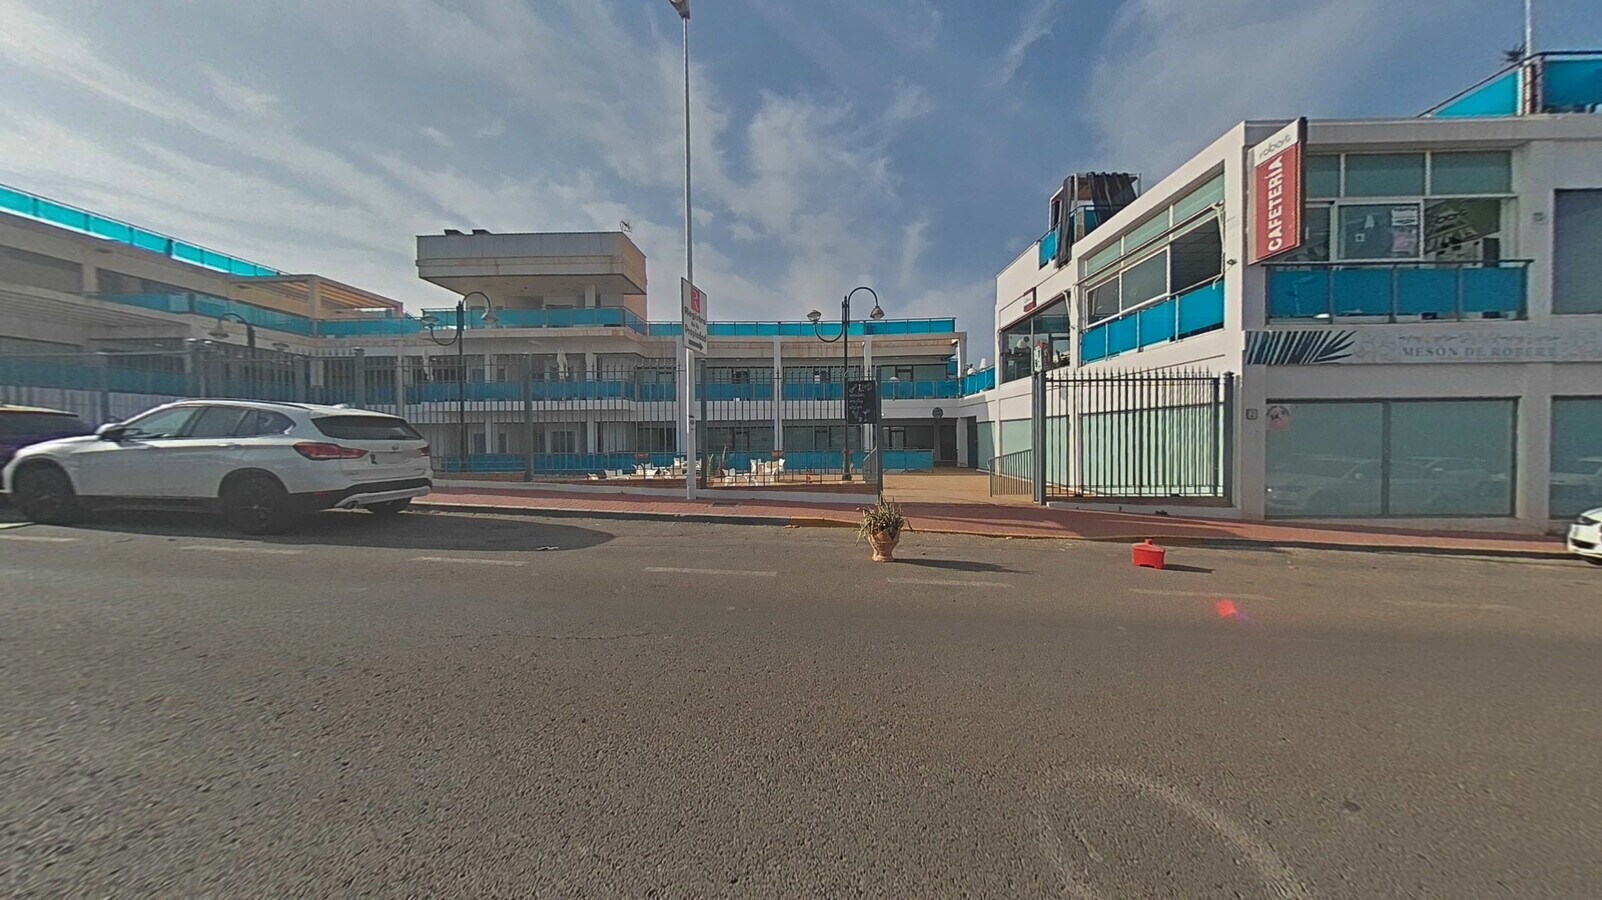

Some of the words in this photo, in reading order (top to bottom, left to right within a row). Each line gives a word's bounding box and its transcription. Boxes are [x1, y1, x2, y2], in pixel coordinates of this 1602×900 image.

[1264, 155, 1283, 251] CAFETERÍA
[685, 306, 706, 325] Registro
[685, 324, 706, 342] Propiedad
